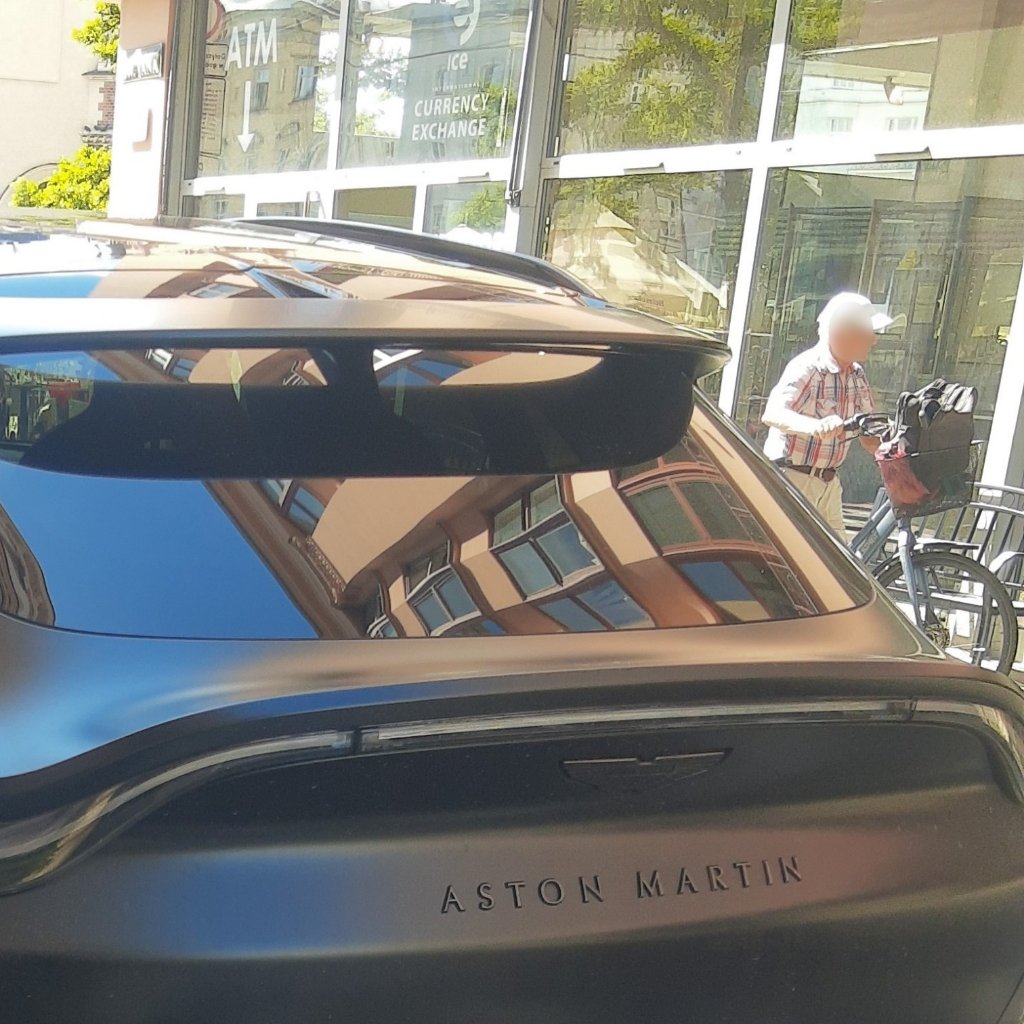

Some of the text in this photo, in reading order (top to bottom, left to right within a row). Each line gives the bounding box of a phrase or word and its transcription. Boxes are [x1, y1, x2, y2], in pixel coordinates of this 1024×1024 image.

[225, 18, 277, 70] ATM
[414, 93, 489, 117] CURRENCY
[411, 118, 487, 141] EXCHANGE
[441, 856, 803, 913] ASTON MARTIN
